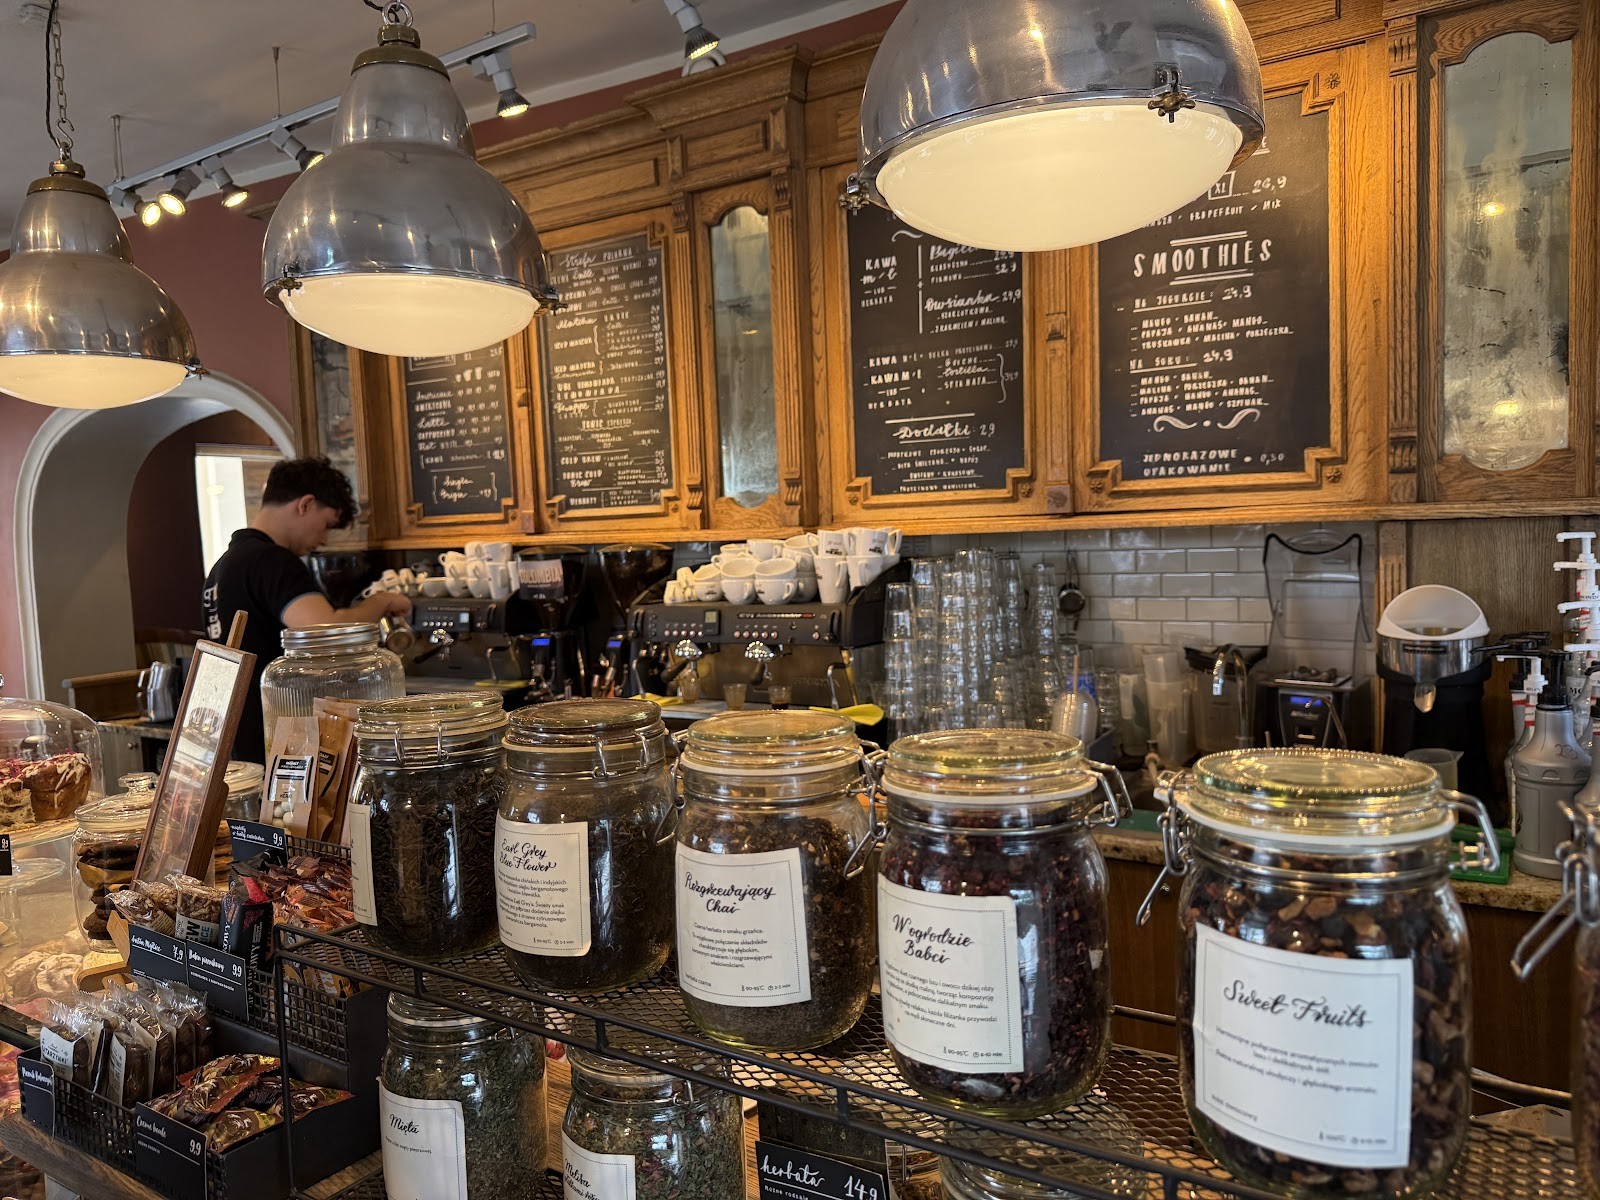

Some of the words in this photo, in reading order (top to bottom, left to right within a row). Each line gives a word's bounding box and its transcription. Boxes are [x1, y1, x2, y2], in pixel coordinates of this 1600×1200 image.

[1190, 206, 1243, 221] GRAPEFRUIT
[1262, 199, 1281, 210] MIX
[865, 256, 897, 271] KAWA
[1134, 239, 1272, 277] SMOOTHIES
[861, 296, 894, 308] HERBATA
[924, 290, 998, 312] Owsianka
[1134, 298, 1147, 309] NA
[1141, 317, 1171, 329] MANGO
[1184, 311, 1215, 324] BANAN
[1141, 327, 1173, 339] PAPAJA
[1187, 320, 1224, 333] ANANAS
[1232, 315, 1263, 328] MANGO
[1141, 337, 1191, 350] TRUSKAWKA
[1203, 333, 1236, 343] MALINA
[869, 355, 897, 368] KAWA
[944, 356, 978, 368] QUICHE
[1129, 359, 1144, 371] NA
[870, 372, 899, 385] KAWA
[942, 366, 988, 378] tortilla
[1140, 376, 1170, 386] MANGO
[1181, 371, 1211, 381] BANAN
[1139, 385, 1172, 396] MALINA
[1238, 375, 1269, 386] BANAN
[1139, 395, 1170, 405] PAPAJA
[1184, 391, 1212, 401] MANGO
[1222, 387, 1255, 397] ANANAS
[868, 398, 913, 410] HERBATA
[1141, 405, 1175, 416] ANANAS
[417, 416, 450, 429] Latte
[561, 456, 579, 466] COLD
[1143, 449, 1238, 464] JEDNORAZOWE
[1143, 463, 1231, 477] OPAKOWANIE
[273, 832, 283, 847] 9,9
[501, 838, 520, 854] Earl
[521, 842, 547, 860] Grey
[513, 856, 557, 872] Flower
[530, 884, 569, 893] bergamotowego
[542, 879, 567, 887] indyjskich
[684, 871, 777, 901] Rozgrzewający
[706, 898, 741, 914] Chai
[892, 914, 912, 933] W
[908, 926, 976, 948] ogrodzie
[903, 939, 951, 964] Babci
[232, 963, 242, 978] 9,9
[961, 983, 981, 993] dzikiej
[958, 992, 995, 1002] kompozycję
[1223, 979, 1290, 1015] Sweet
[1291, 995, 1374, 1029] Fruits
[966, 1015, 998, 1023] przywodzi
[389, 1113, 420, 1136] Mięta
[189, 1139, 202, 1156] 9,9
[760, 1154, 826, 1188] herbata
